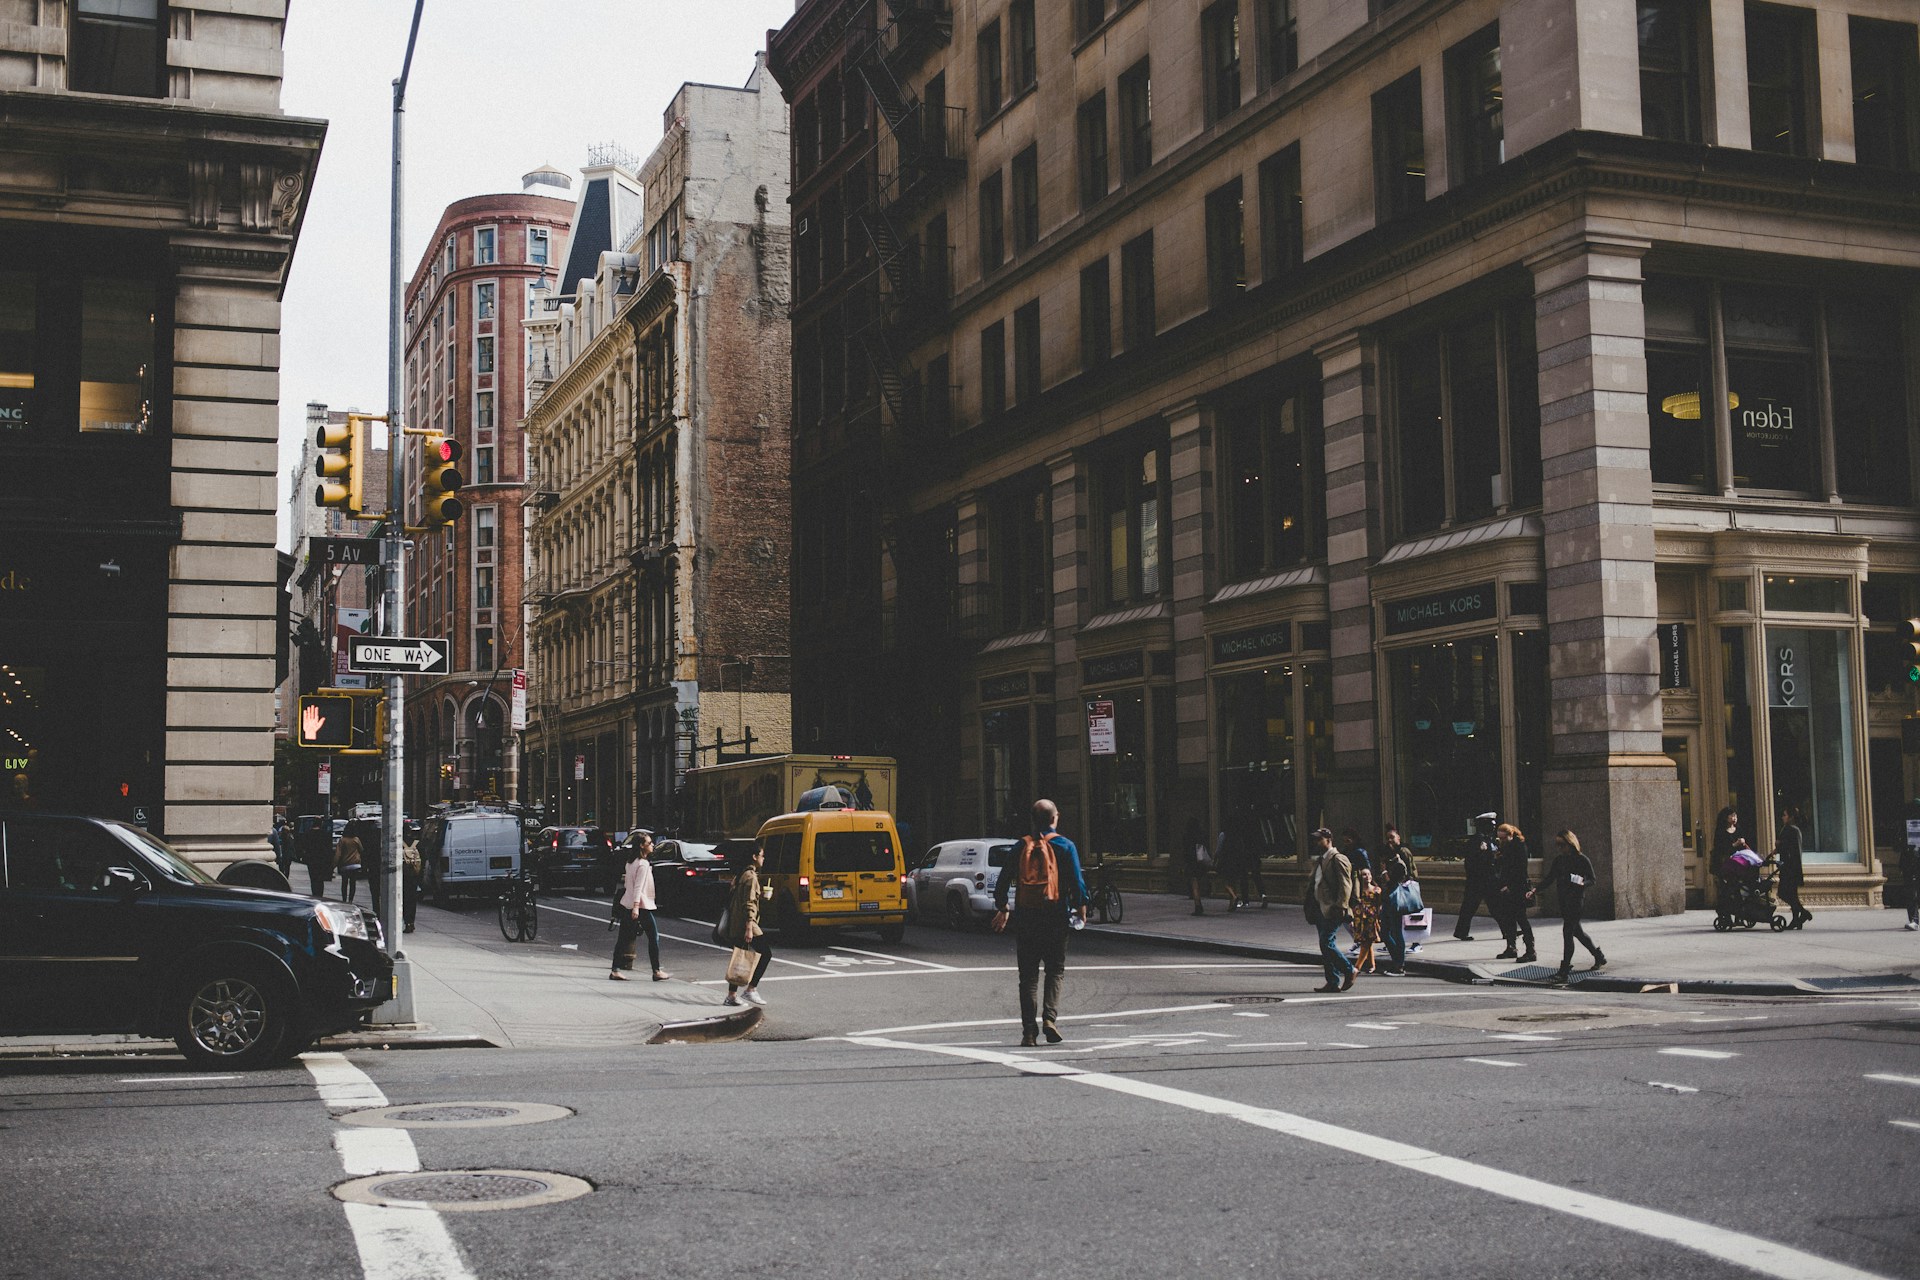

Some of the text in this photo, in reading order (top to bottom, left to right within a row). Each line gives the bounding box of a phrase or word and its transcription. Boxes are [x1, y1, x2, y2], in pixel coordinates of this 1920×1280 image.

[327, 544, 361, 561] 5 Av
[1397, 594, 1482, 623] MICHAEL KORS
[364, 648, 433, 662] ONE WAY
[1221, 631, 1284, 655] MICHAEL KORS
[1780, 648, 1795, 706] KORS
